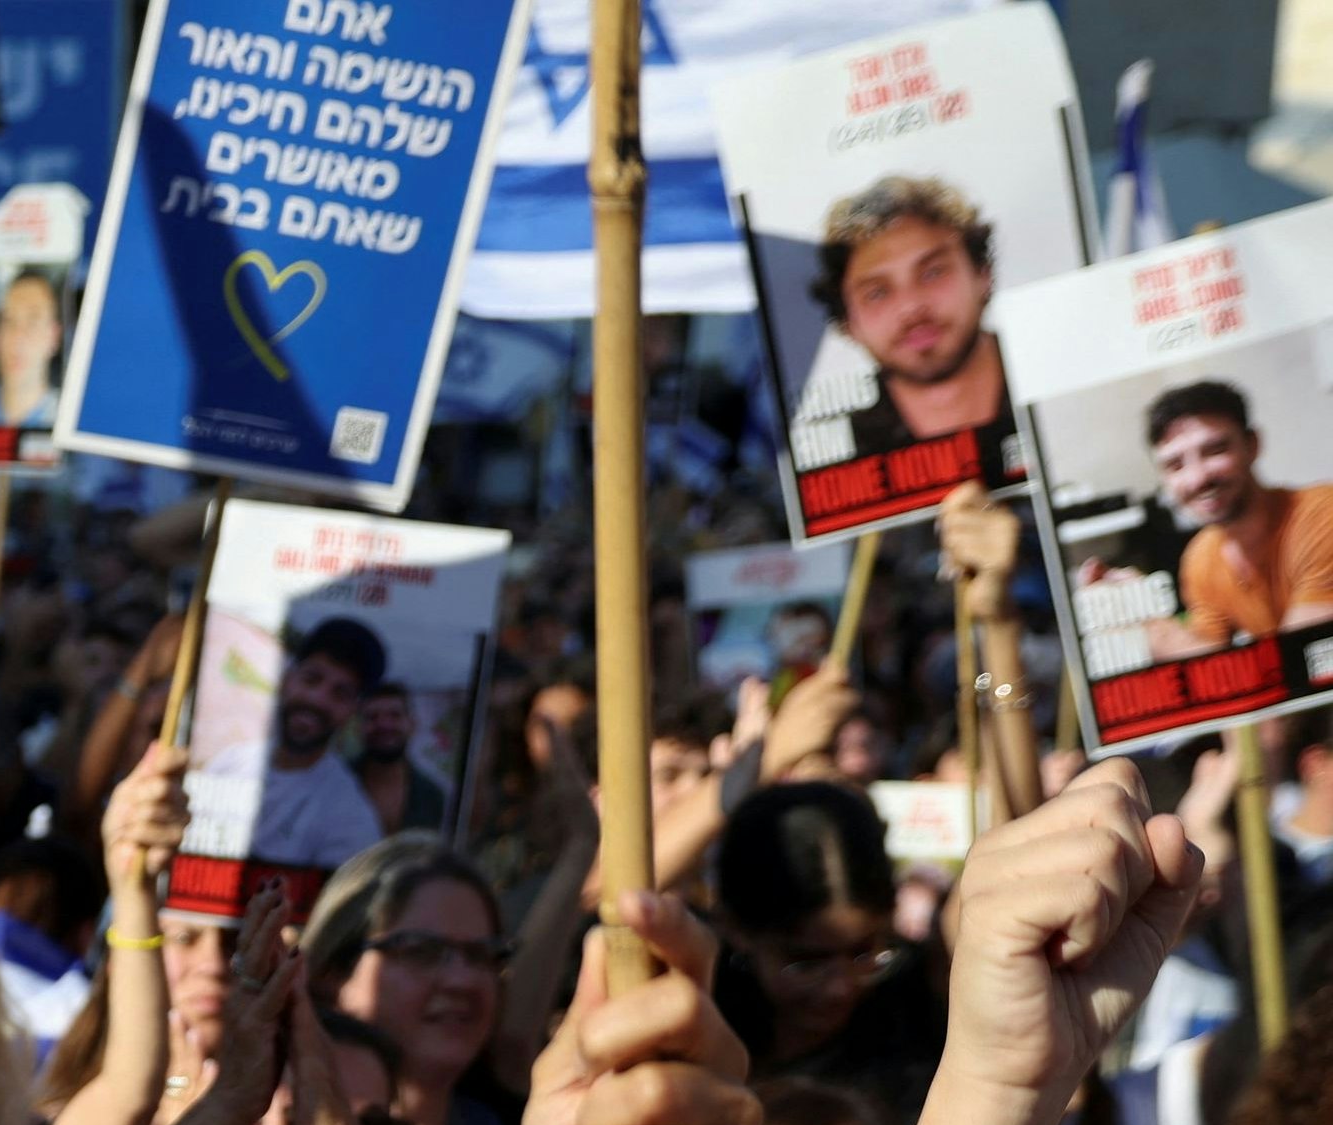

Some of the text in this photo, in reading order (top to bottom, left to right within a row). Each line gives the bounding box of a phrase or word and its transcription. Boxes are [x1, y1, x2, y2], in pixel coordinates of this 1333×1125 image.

[284, 0, 393, 44] אתם
[179, 22, 476, 113] הנשימה והאור
[172, 75, 453, 158] שלהם חיכינו,
[205, 130, 401, 201] מאושרים
[161, 175, 423, 255] שאתם בבית
[800, 455, 886, 518] HOME
[887, 425, 980, 493] NOW!
[1092, 663, 1185, 727] HOME
[1185, 635, 1282, 702] NOW!
